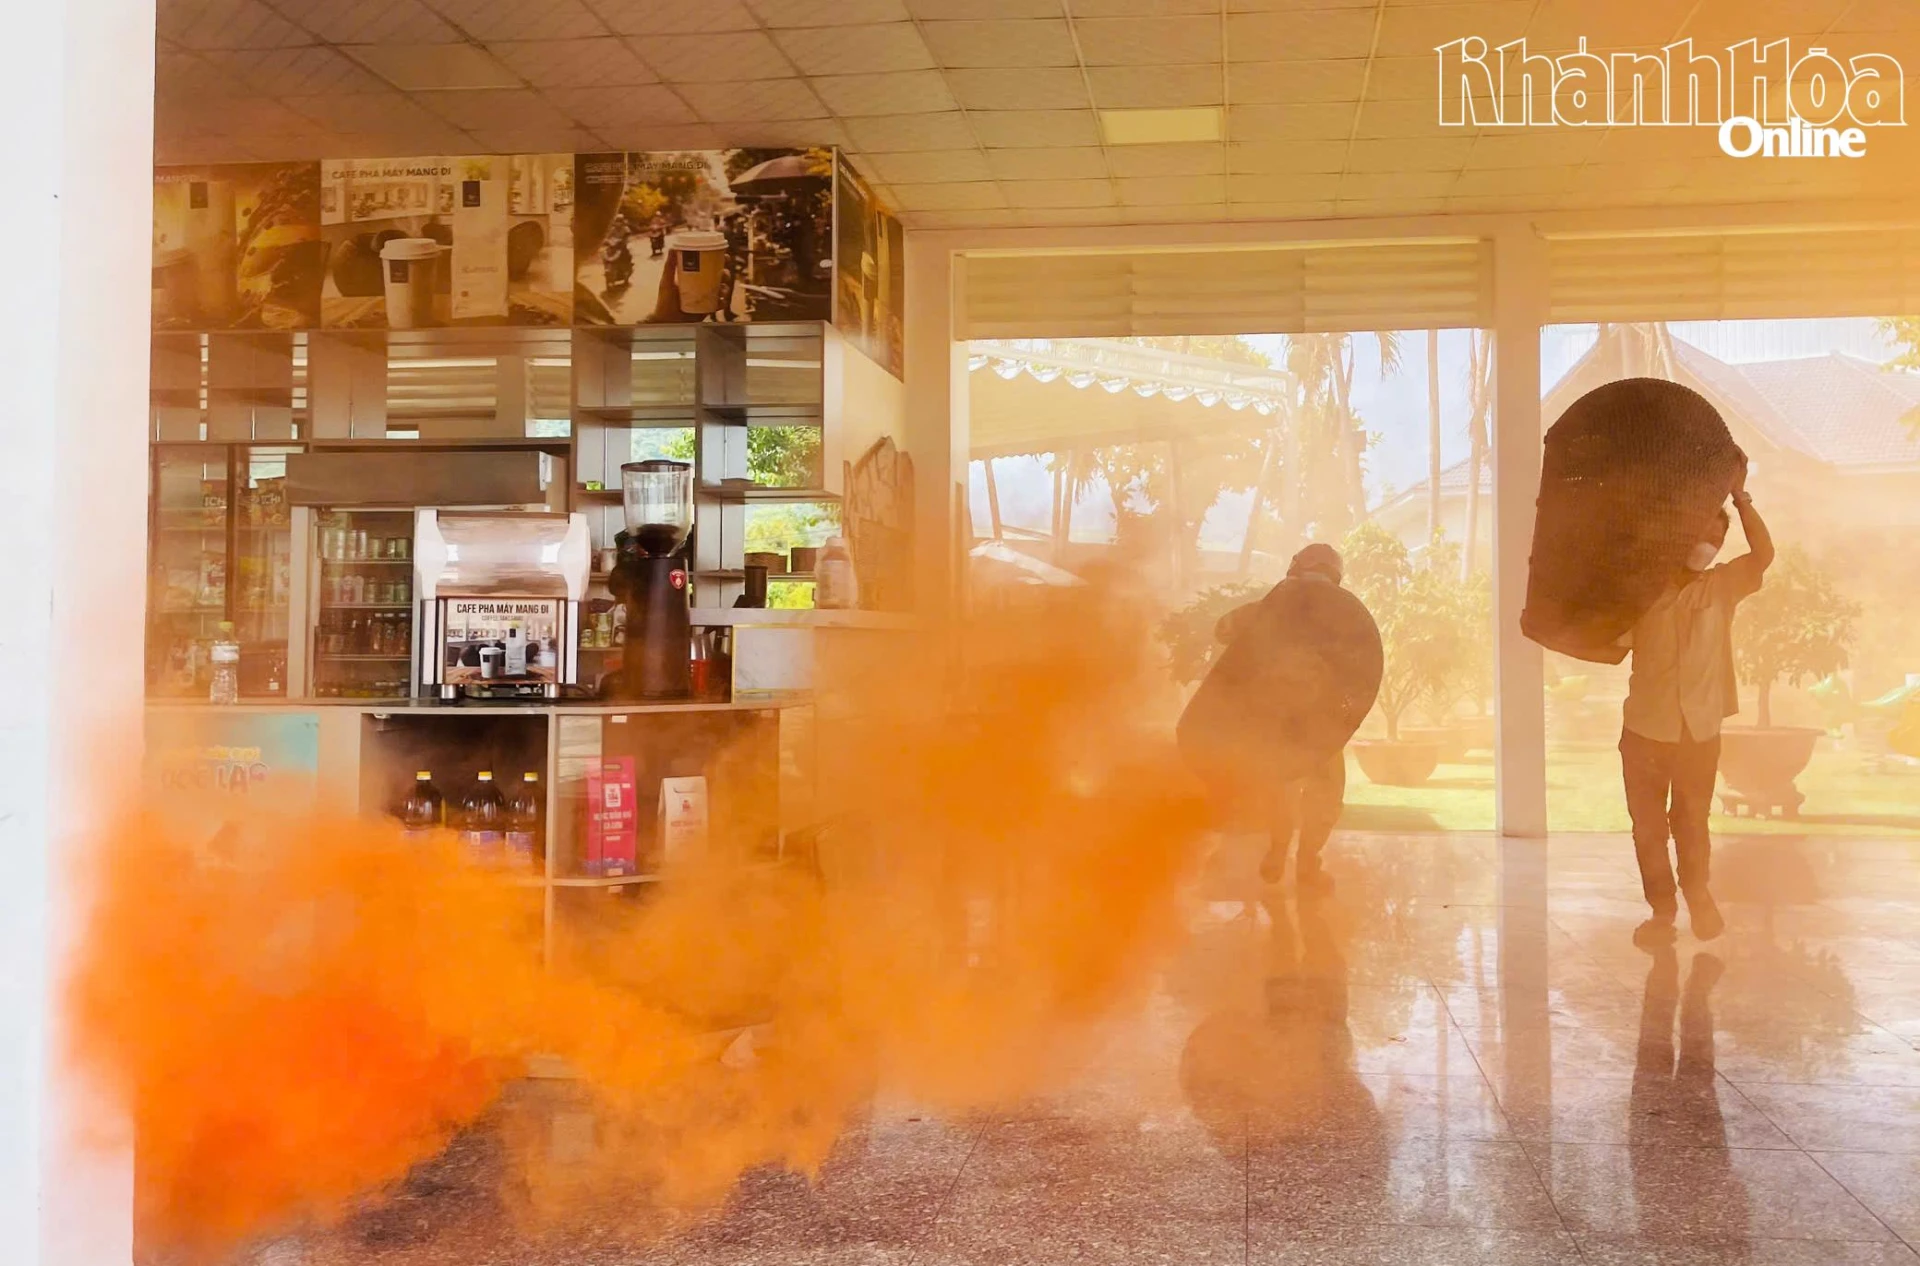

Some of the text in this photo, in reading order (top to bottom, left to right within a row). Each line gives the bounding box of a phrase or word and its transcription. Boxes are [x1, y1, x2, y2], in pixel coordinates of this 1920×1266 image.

[406, 167, 438, 176] MANG
[456, 603, 477, 614] CAFE
[479, 603, 495, 614] PHA
[515, 604, 539, 614] MANG
